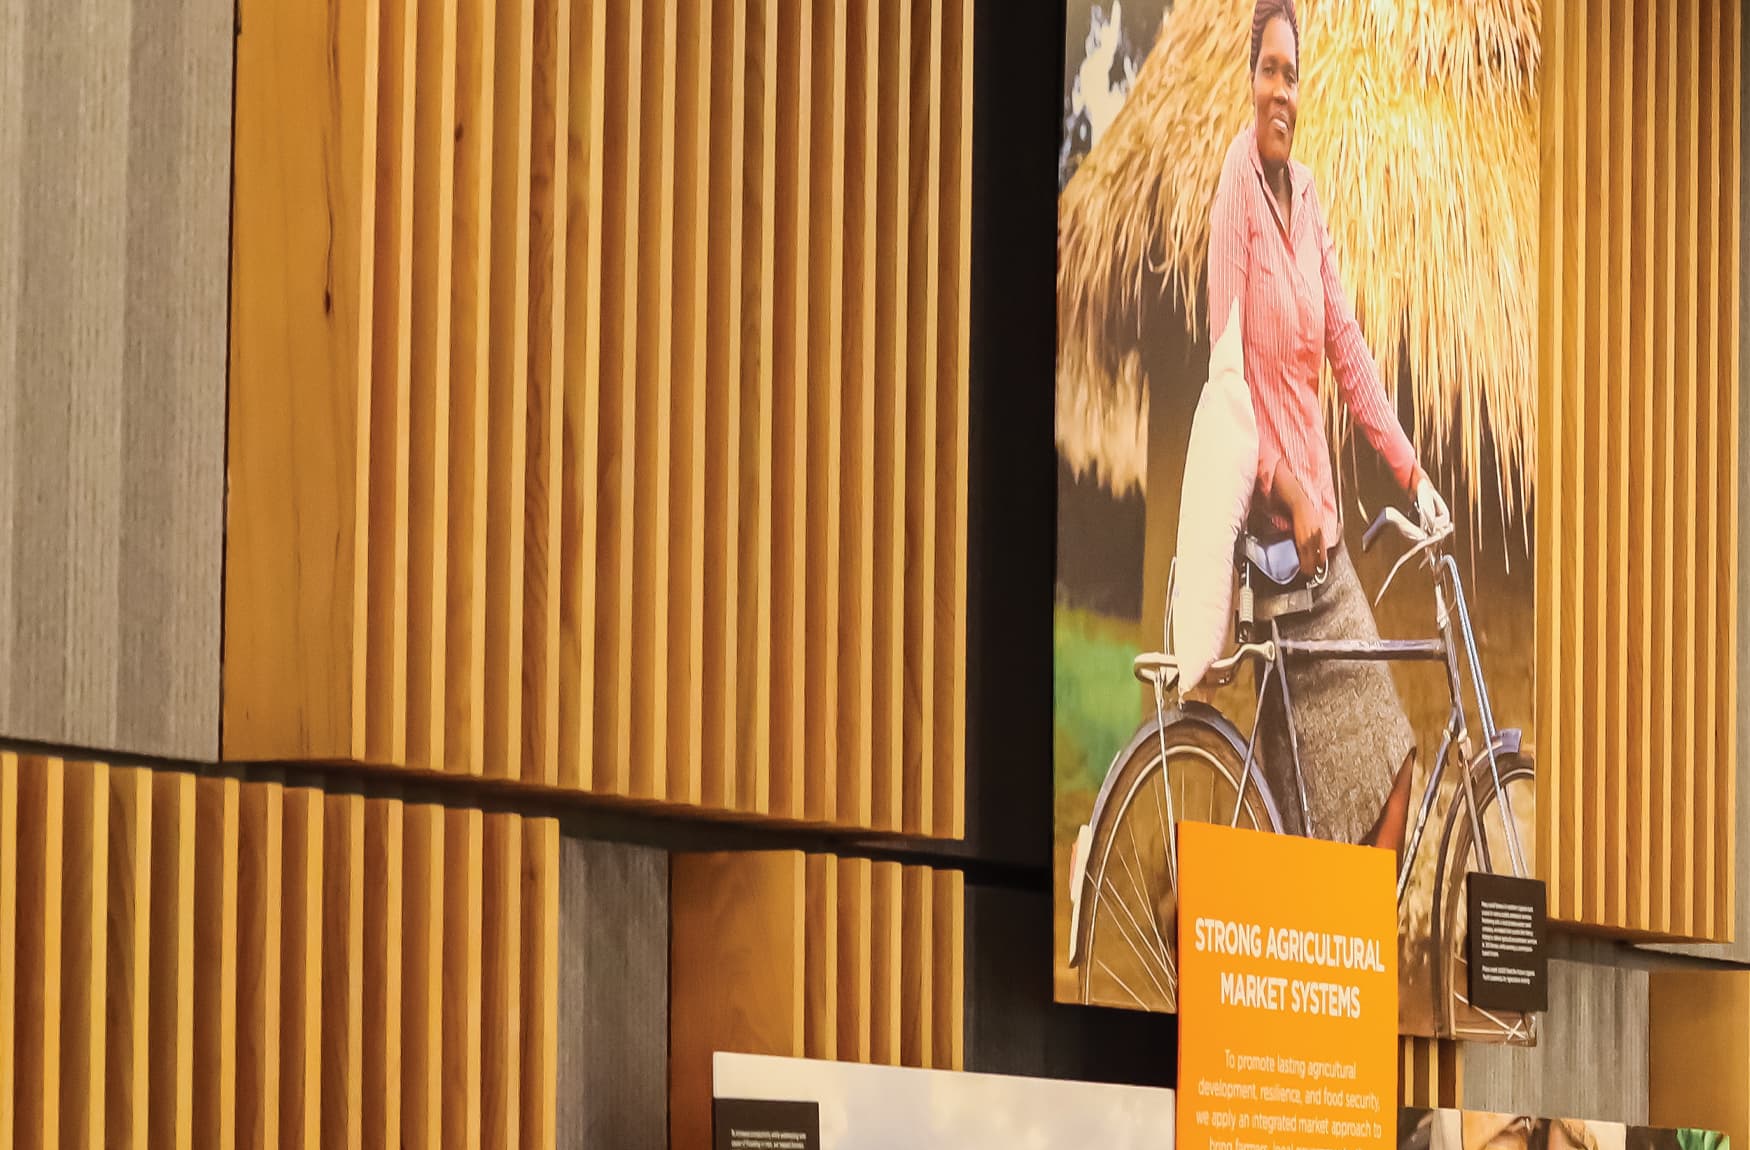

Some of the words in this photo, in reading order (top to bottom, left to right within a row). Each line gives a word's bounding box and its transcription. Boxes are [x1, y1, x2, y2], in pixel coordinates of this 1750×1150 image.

[1195, 917, 1262, 958] STRONG
[1266, 927, 1385, 972] AGRICULTURAL
[1220, 972, 1288, 1011] MARKET
[1291, 979, 1361, 1019] SYSTEMS
[1225, 1049, 1235, 1069] To
[1237, 1054, 1275, 1073] promote
[1278, 1055, 1306, 1079] lasting
[1308, 1062, 1356, 1080] agricultural
[1198, 1076, 1257, 1100] development,
[1305, 1088, 1321, 1105] and
[1323, 1086, 1343, 1107] food
[1346, 1093, 1380, 1112] security,
[1196, 1110, 1209, 1126] we
[1211, 1109, 1236, 1131] apply
[1238, 1113, 1249, 1128] an
[1252, 1112, 1297, 1134] integrated
[1299, 1116, 1329, 1135] market
[1331, 1119, 1371, 1138] approach
[1373, 1122, 1382, 1139] to
